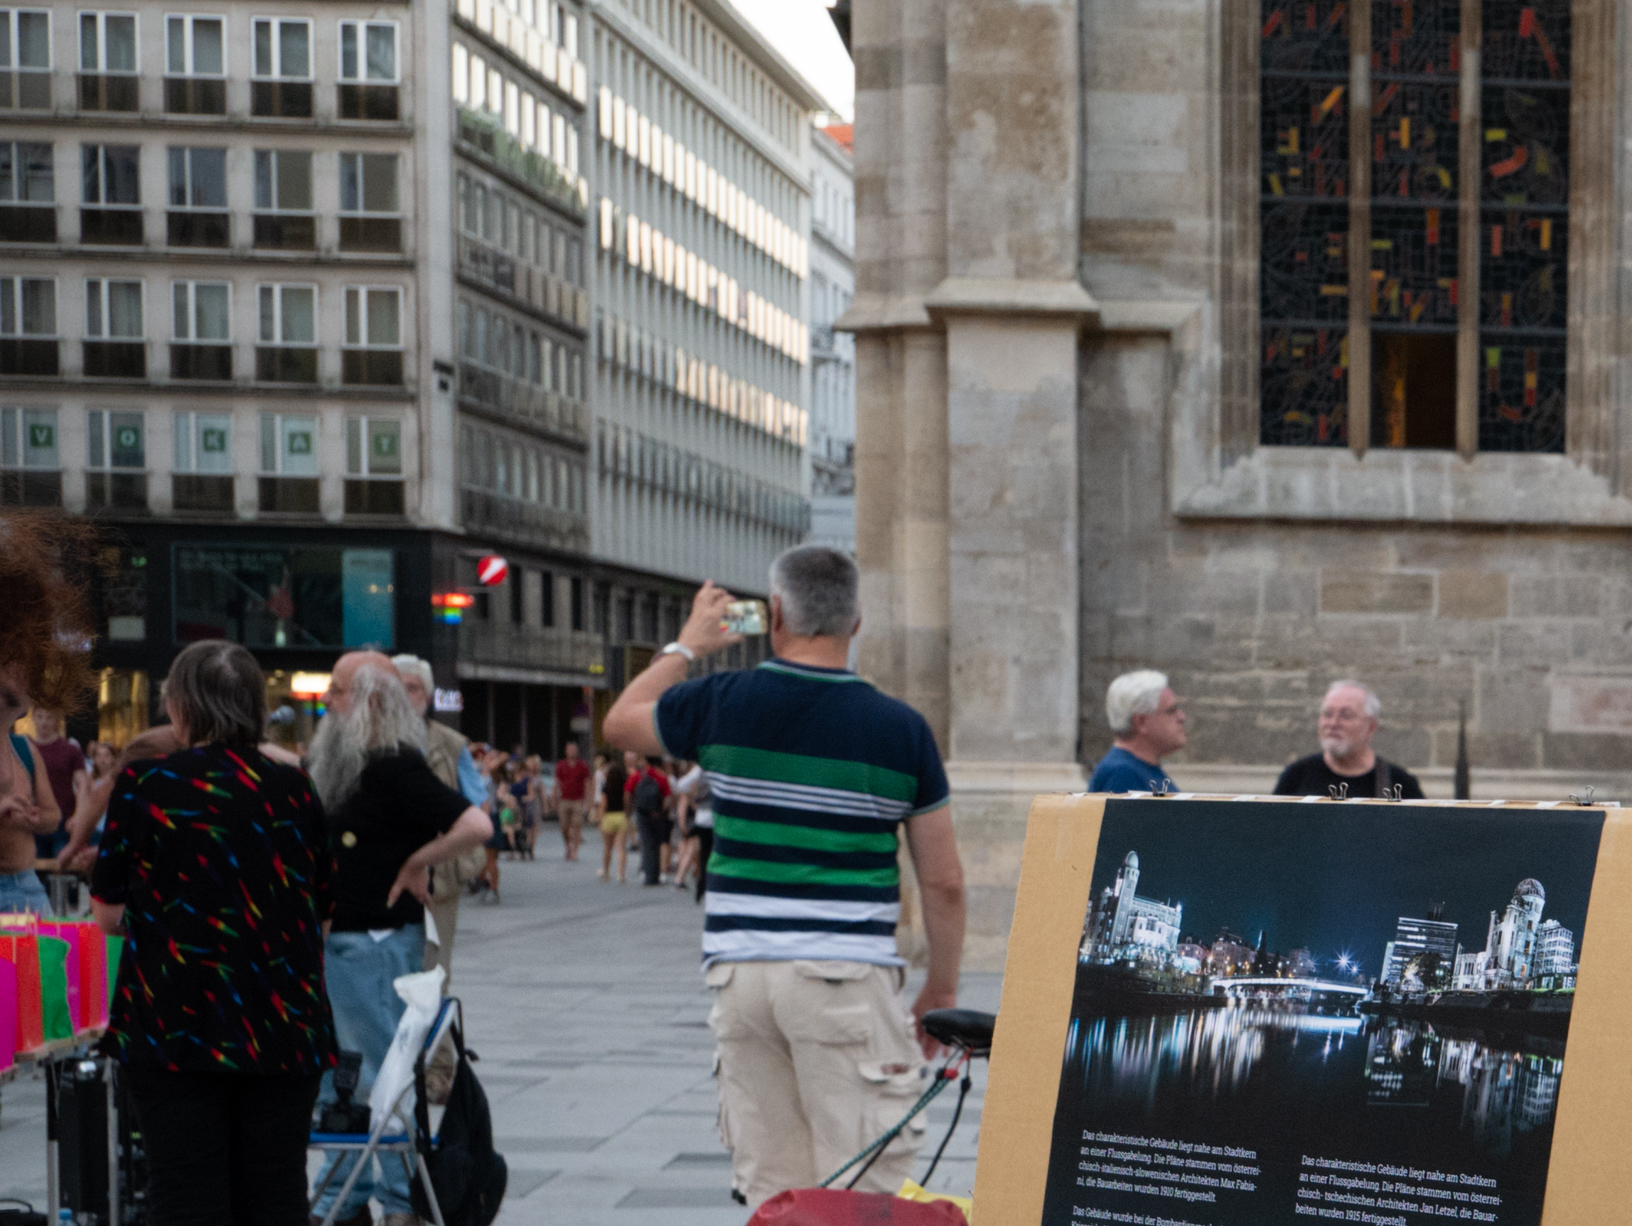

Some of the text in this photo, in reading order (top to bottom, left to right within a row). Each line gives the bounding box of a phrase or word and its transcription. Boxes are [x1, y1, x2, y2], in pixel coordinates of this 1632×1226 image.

[1082, 1130, 1256, 1159] Das charakteristische Gebäude liegt nahe am Stadtkern
[1078, 1160, 1179, 1181] chisch-italienisch-slowenischen
[1180, 1172, 1219, 1186] Architekten
[1220, 1177, 1234, 1188] Max
[1090, 1146, 1106, 1156] einer
[1153, 1153, 1164, 1164] Die
[1165, 1155, 1184, 1166] Pläne
[1185, 1158, 1216, 1170] stammen
[1217, 1163, 1232, 1172] vom
[1232, 1163, 1260, 1175] österrei-
[1301, 1155, 1496, 1187] Das charakteristische Gebäude liegt nahe am Stadtkern
[1085, 1176, 1095, 1186] die
[1096, 1178, 1132, 1191] Bauarbeiten
[1134, 1184, 1158, 1194] wurden
[1160, 1186, 1174, 1196] 1910
[1299, 1173, 1308, 1181] an
[1309, 1172, 1327, 1183] einer
[1381, 1181, 1393, 1192] Die
[1394, 1182, 1415, 1194] Pläne
[1416, 1186, 1451, 1199] stammen
[1452, 1192, 1469, 1201] vom
[1470, 1192, 1502, 1205] österrei-
[1072, 1205, 1084, 1216] Das
[1085, 1207, 1111, 1219] Gebäude
[1112, 1212, 1132, 1222] wurde
[1133, 1214, 1144, 1224] bei
[1144, 1215, 1155, 1225] der
[1295, 1203, 1316, 1215] beiten
[1318, 1207, 1344, 1218] wurden
[1345, 1209, 1360, 1220] 1915
[1324, 1190, 1374, 1206] tschechischen
[1376, 1197, 1418, 1211] Architekten
[1420, 1202, 1433, 1213] Jan
[1459, 1207, 1471, 1218] die
[1472, 1209, 1498, 1221] Bauar-
